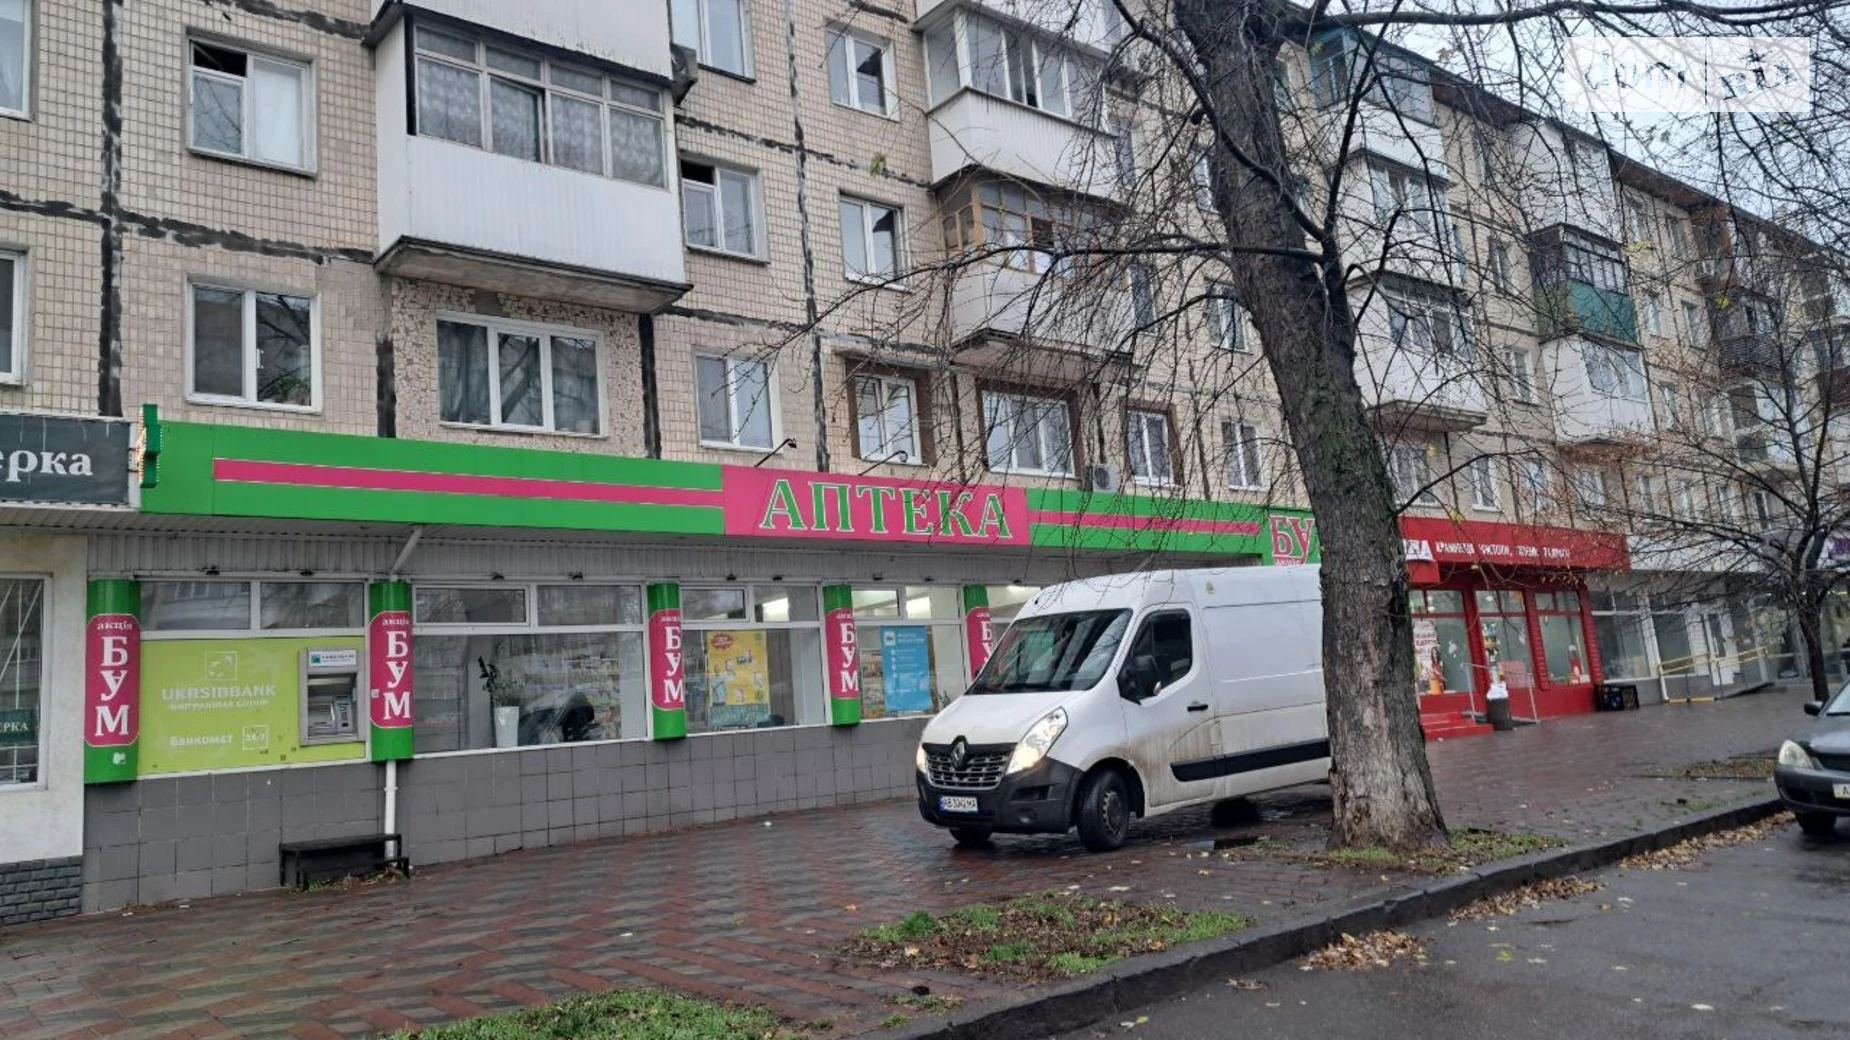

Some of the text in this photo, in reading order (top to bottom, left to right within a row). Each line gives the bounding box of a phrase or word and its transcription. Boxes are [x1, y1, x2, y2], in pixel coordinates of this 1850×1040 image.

[0, 449, 93, 482] рка
[758, 478, 1013, 539] АПТЕКА
[1270, 515, 1315, 566] БУ
[663, 626, 684, 703] БУМ
[840, 622, 859, 693] БУМ
[980, 620, 994, 663] БУ
[95, 636, 130, 737] БУМ
[382, 630, 412, 720] БУМ
[0, 721, 29, 732] РКА
